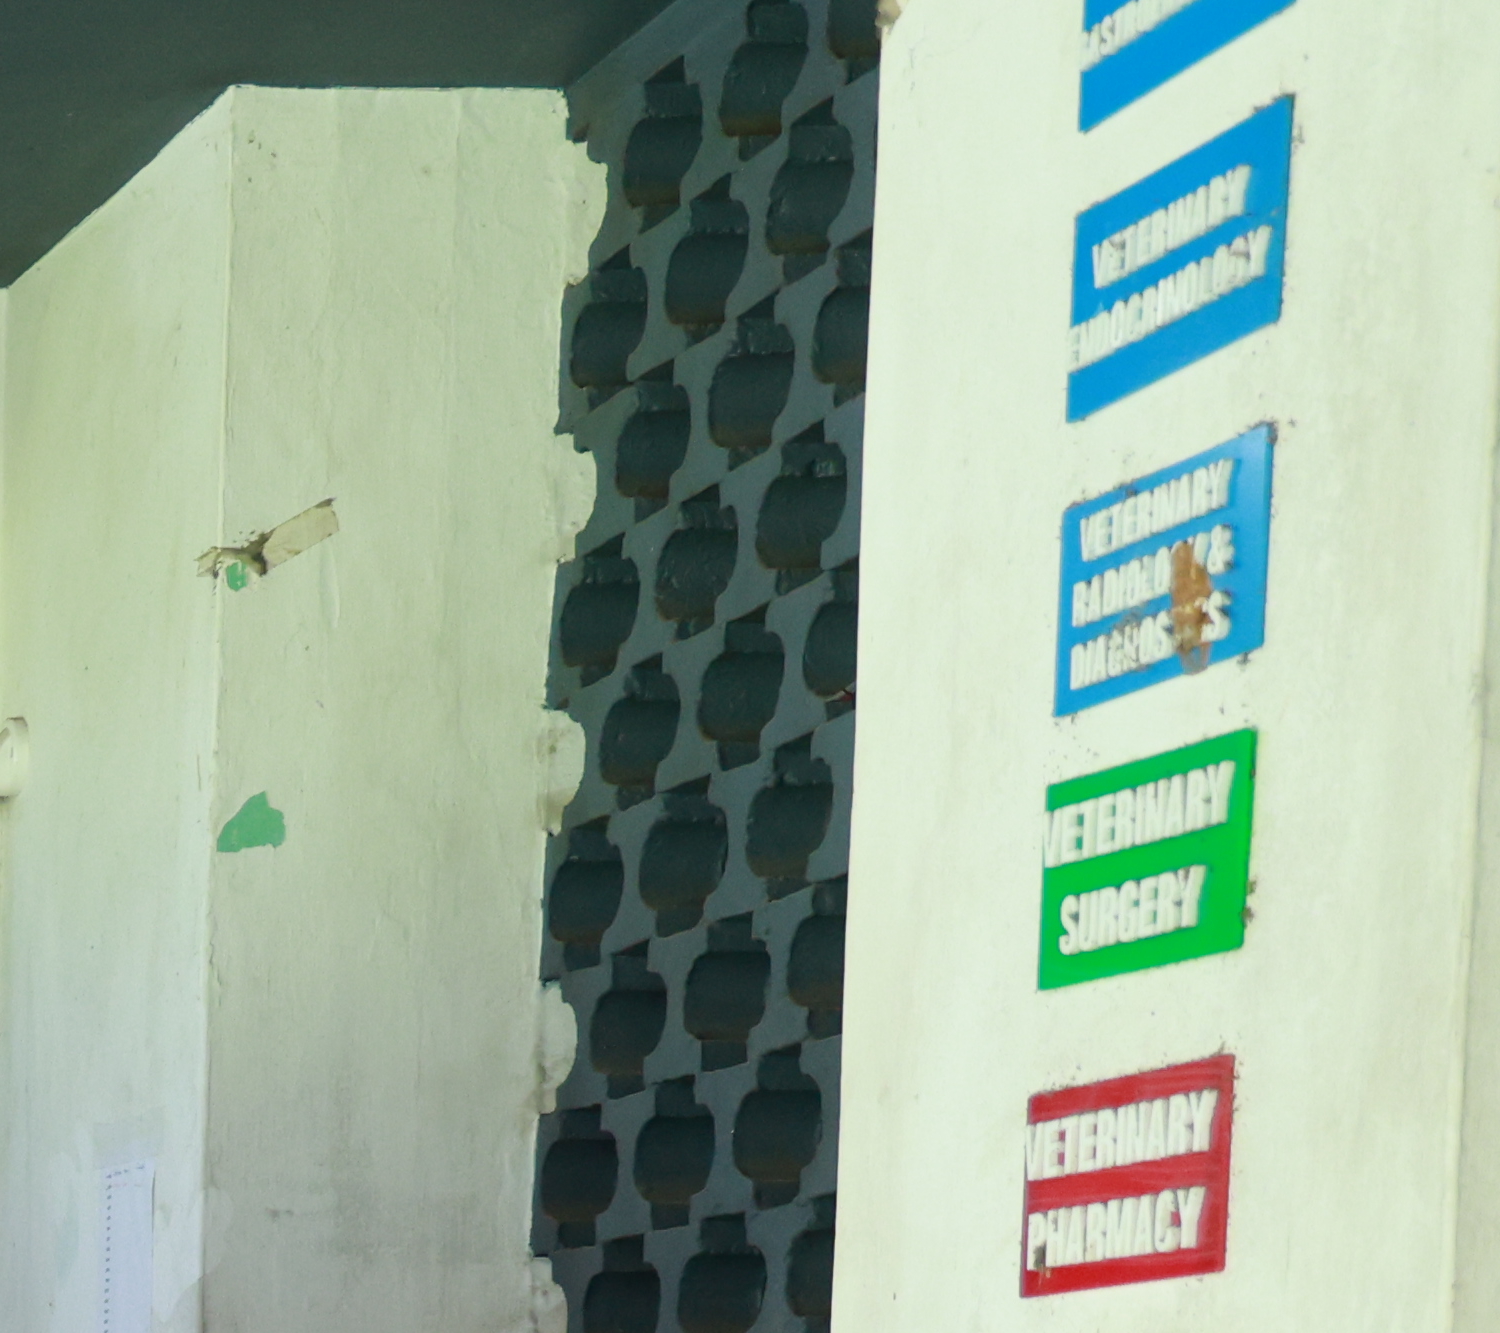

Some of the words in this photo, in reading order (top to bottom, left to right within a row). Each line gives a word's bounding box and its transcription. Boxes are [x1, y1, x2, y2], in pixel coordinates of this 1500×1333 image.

[1092, 163, 1253, 290] VETERINARY
[1067, 223, 1273, 375] ENDOCRINOLOGY
[1079, 457, 1235, 563] VETERINARY
[1206, 523, 1236, 576] &
[1043, 760, 1237, 868] VETERINARY
[1058, 864, 1208, 956] SURGERY
[1025, 1088, 1220, 1182] VETERINARY
[1026, 1186, 1207, 1272] PHARMACY
